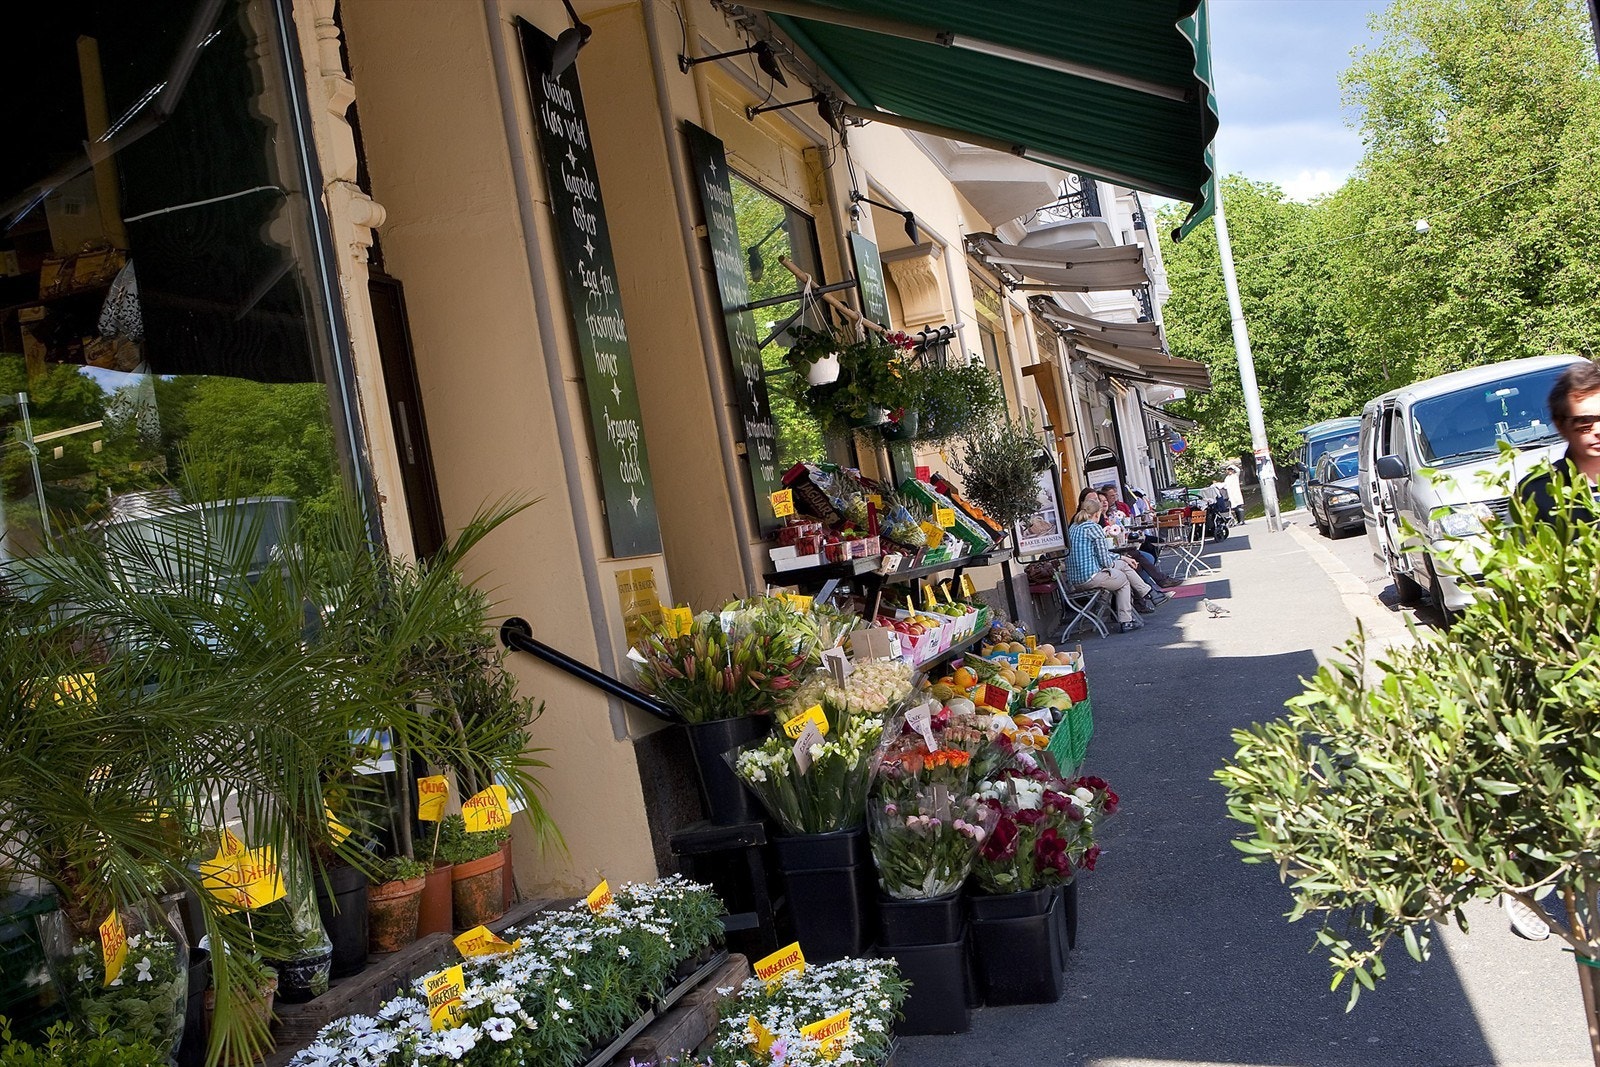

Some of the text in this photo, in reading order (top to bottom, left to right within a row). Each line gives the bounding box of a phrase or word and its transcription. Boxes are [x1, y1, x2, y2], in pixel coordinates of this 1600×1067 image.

[565, 118, 588, 150] vekt
[578, 259, 602, 309] Egg
[619, 444, 645, 485] eddik
